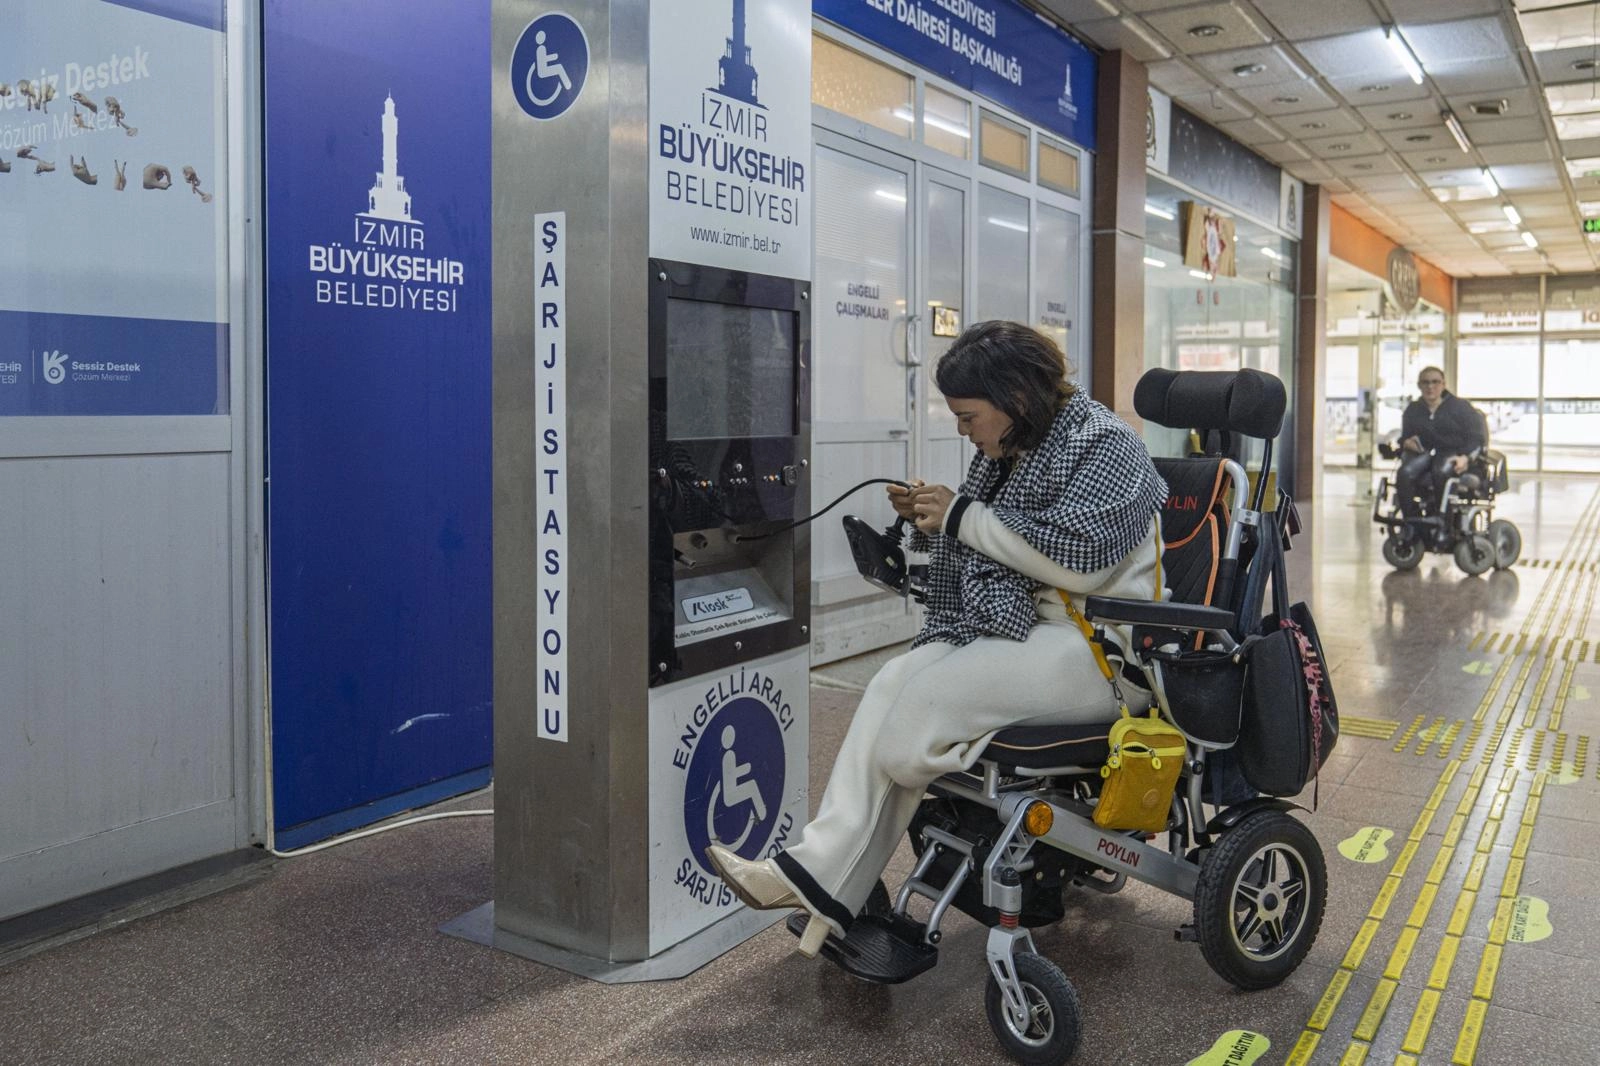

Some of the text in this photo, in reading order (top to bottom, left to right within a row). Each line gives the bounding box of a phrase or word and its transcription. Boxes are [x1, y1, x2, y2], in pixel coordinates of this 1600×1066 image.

[897, 0, 950, 47] DAİRESİ
[952, 27, 1022, 86] BAŞKANLIĞI
[65, 46, 150, 98] Destek
[702, 93, 767, 143] İZMİR
[660, 122, 804, 193] BÜYÜKŞEHİR
[667, 169, 798, 227] BELEDİYESİ
[354, 218, 425, 251] İZMİR
[690, 226, 781, 254] www.izmir.bel.tr
[309, 243, 464, 285] BÜYÜKŞEHİR
[316, 279, 457, 312] BELEDİYESİ
[0, 373, 17, 384] ESİ
[71, 361, 141, 372] Sessiz Destek
[692, 597, 729, 616] Kiosk
[672, 666, 794, 770] ENGELLİ ARACI
[1096, 837, 1140, 867] POYLIN
